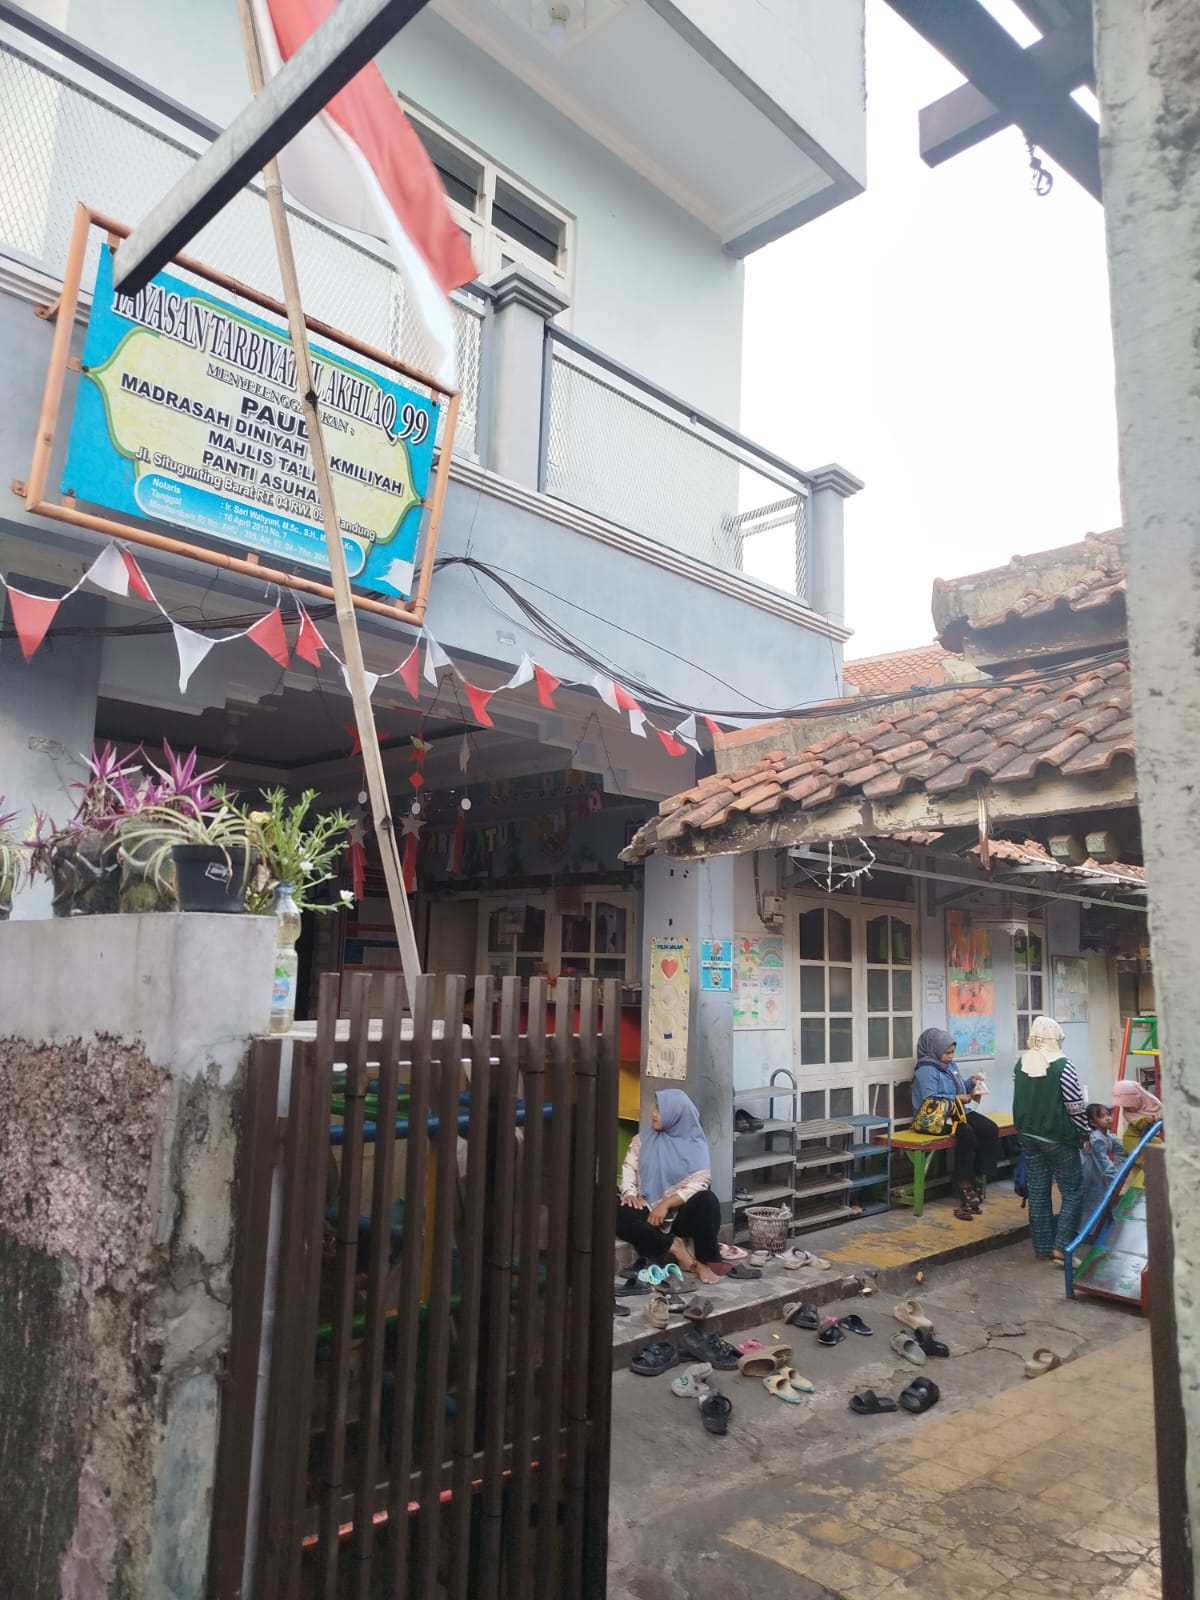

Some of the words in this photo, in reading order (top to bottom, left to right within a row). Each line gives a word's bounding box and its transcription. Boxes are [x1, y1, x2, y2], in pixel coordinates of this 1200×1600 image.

[207, 363, 350, 434] MENYELENGGKAN
[208, 314, 324, 400] TARBIYATL
[324, 368, 397, 442] AKHLAQ
[400, 403, 428, 443] 99
[121, 372, 230, 428] MADRASAH
[235, 418, 306, 457] DINIYAH
[329, 456, 404, 496] KMILIYAH
[208, 430, 273, 466] MAJLIS
[278, 456, 317, 482] TA'LI
[135, 446, 151, 464] Jl.
[153, 452, 223, 491] Situgunting
[223, 481, 257, 500] Barat
[256, 489, 274, 507] RT.
[274, 494, 289, 512] 04
[290, 499, 312, 519] RW.
[339, 518, 377, 542] andung
[151, 477, 181, 494] Notaris
[151, 487, 182, 505] Tanggal
[233, 514, 251, 529] April
[202, 450, 255, 480] PANTI
[260, 472, 321, 505] ASUHA
